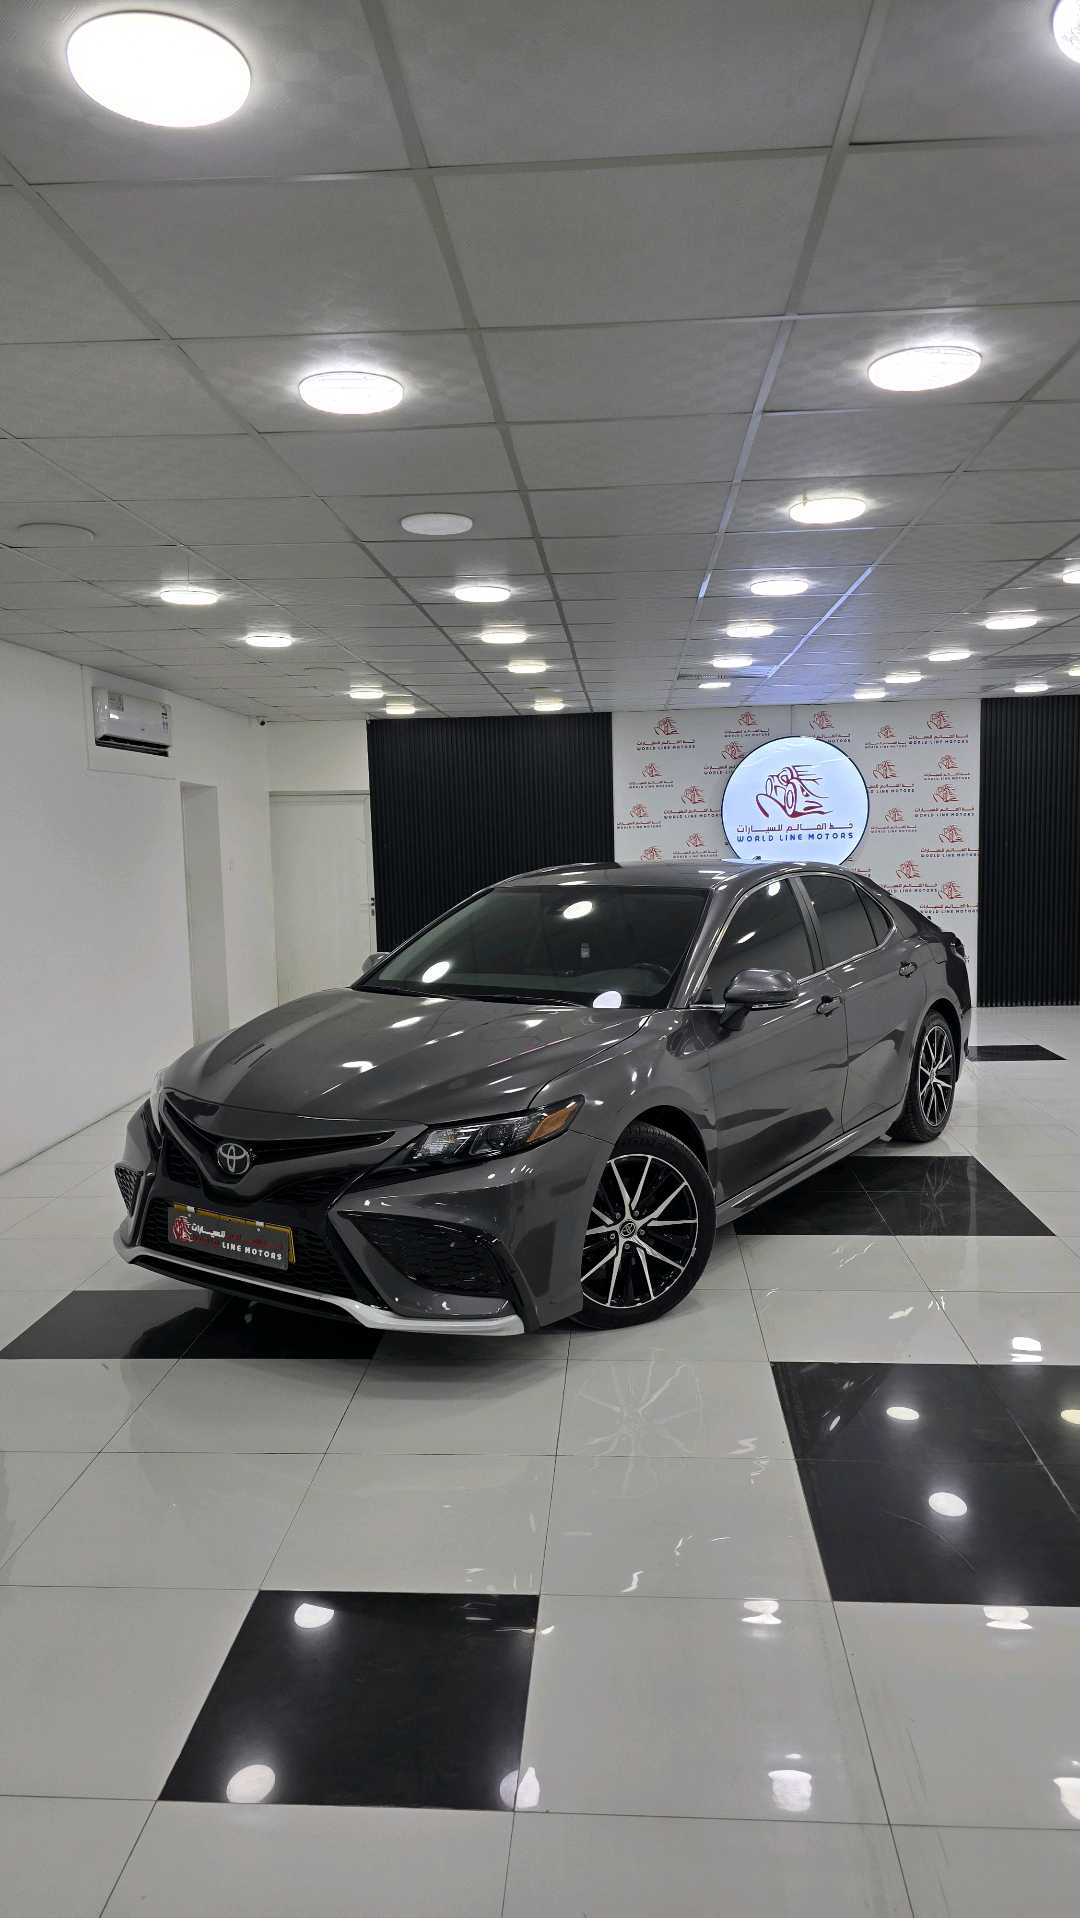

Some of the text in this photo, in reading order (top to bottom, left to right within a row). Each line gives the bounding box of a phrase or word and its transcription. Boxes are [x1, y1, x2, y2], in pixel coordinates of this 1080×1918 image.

[737, 832, 853, 842] WORLD LINE MOTORS
[222, 1241, 242, 1252] LINE
[244, 1245, 282, 1261] MOTORS
